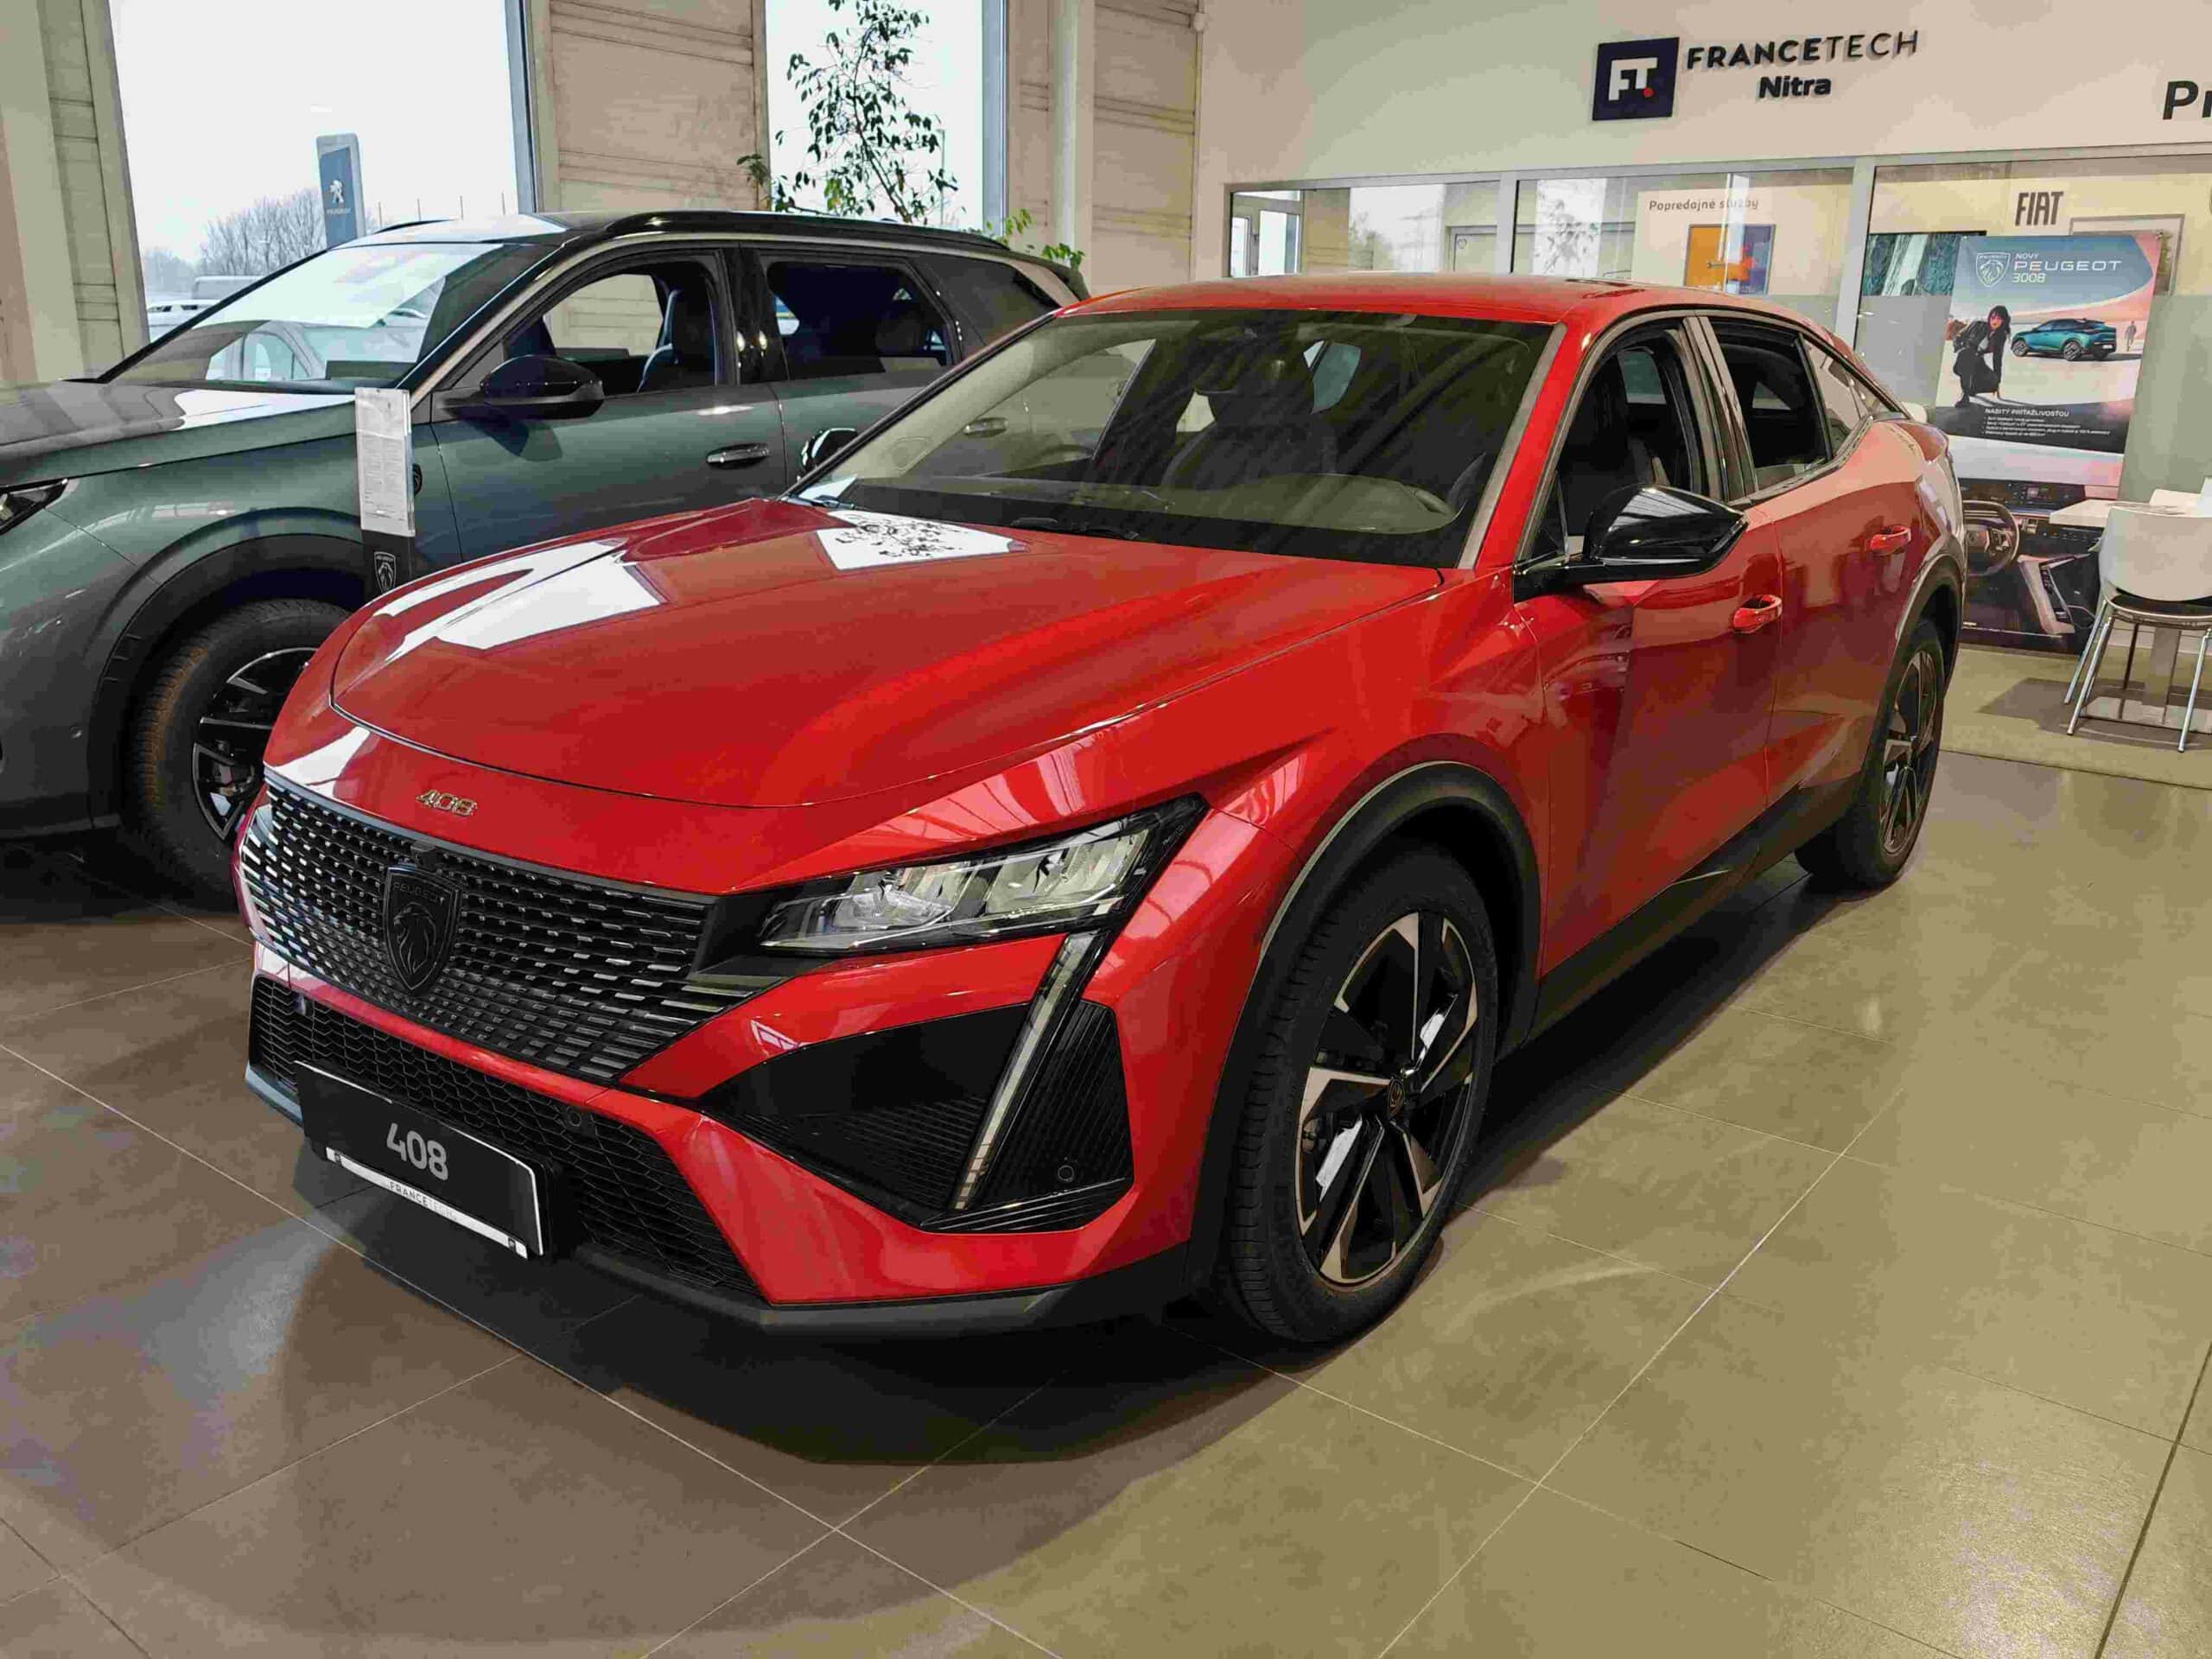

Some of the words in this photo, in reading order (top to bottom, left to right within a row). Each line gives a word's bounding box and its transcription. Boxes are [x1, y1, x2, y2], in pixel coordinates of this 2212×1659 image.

[1687, 30, 1919, 70] FRANCETECH
[1758, 74, 1833, 99] Nitra
[1649, 199, 1716, 211] Popredajné
[2014, 190, 2063, 226] FIAT
[2012, 272, 2046, 283] 3008
[2014, 260, 2122, 271] PEUGEOT
[416, 790, 477, 816] 408
[387, 1123, 448, 1180] 408
